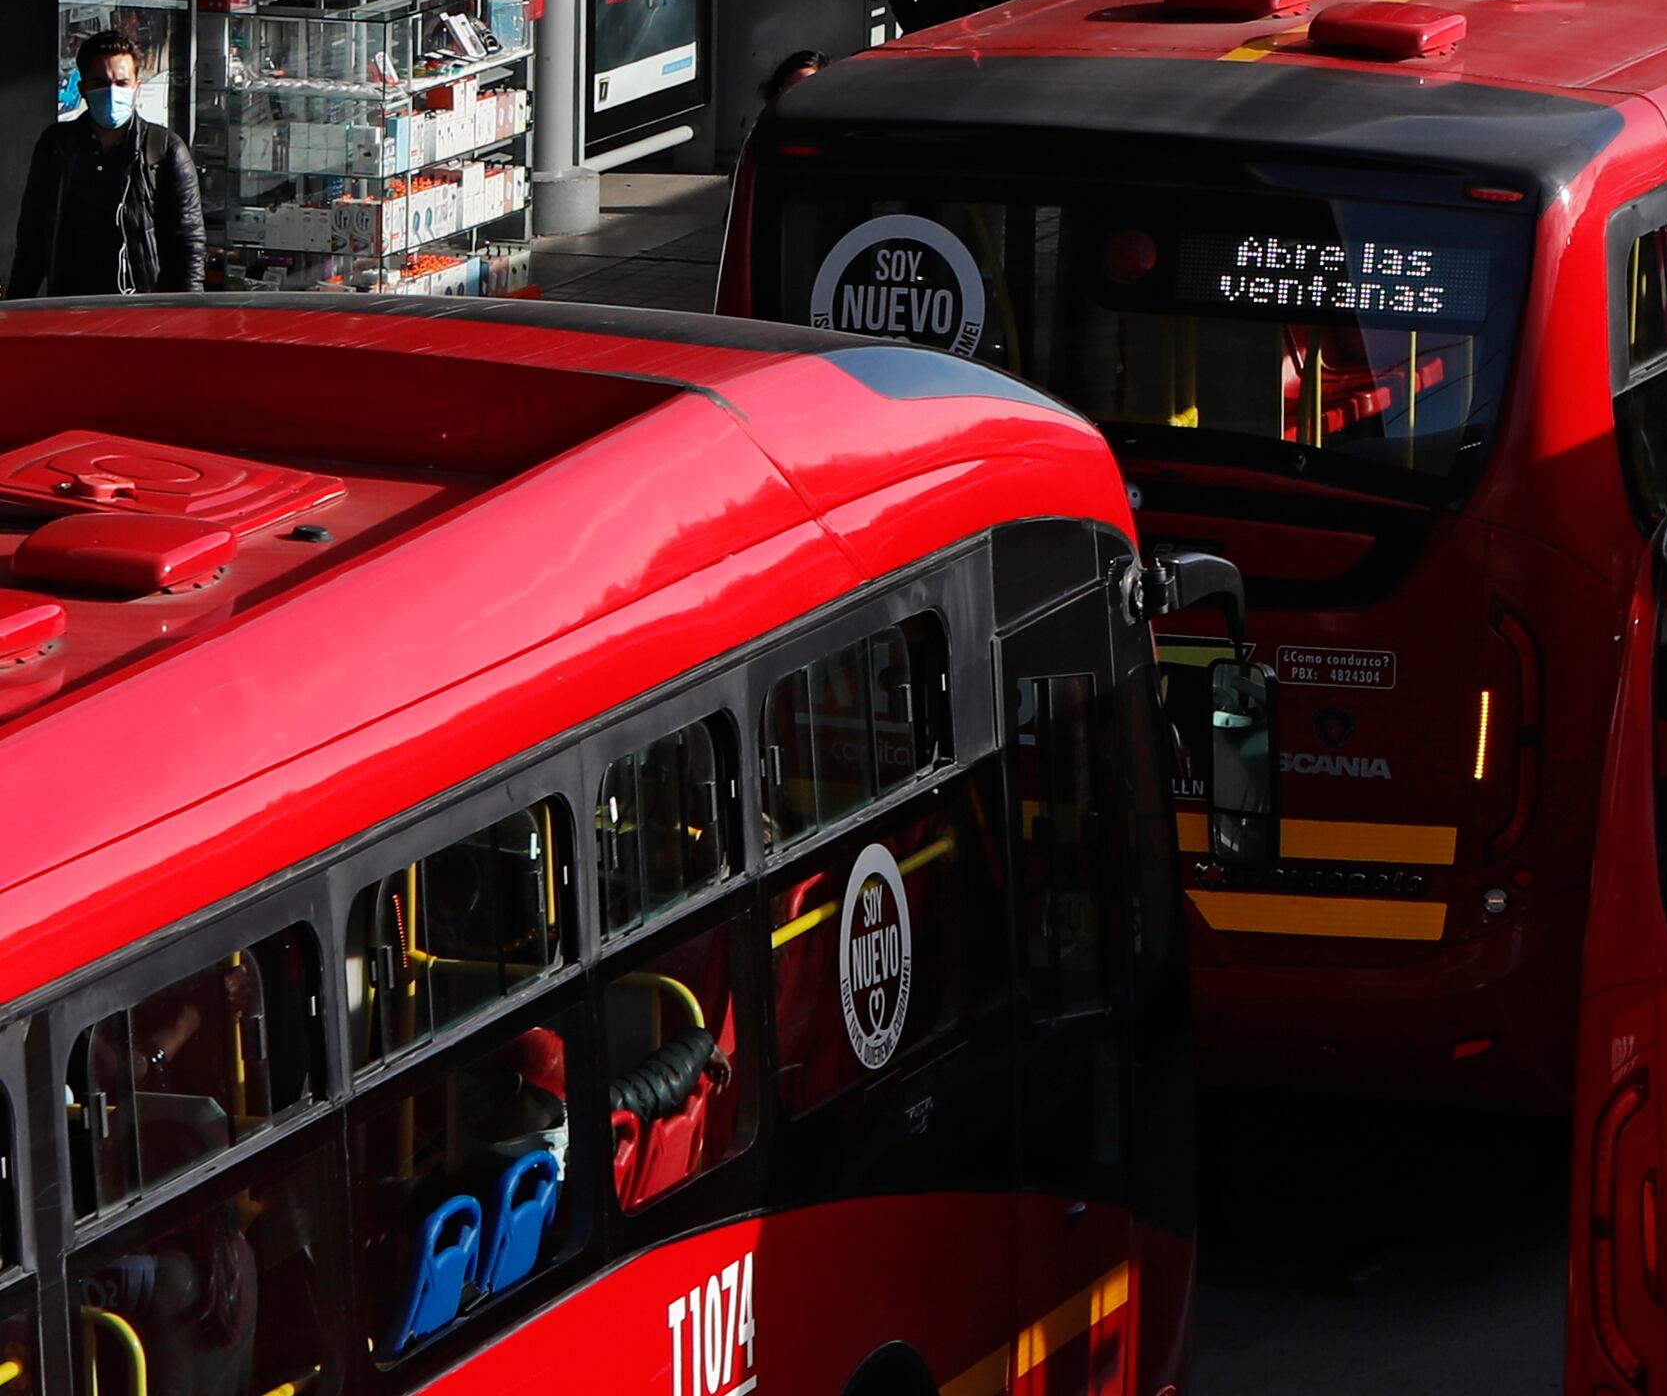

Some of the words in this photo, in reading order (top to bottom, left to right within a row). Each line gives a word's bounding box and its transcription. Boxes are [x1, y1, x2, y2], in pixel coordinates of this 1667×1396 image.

[875, 249, 923, 282] SOY
[1236, 236, 1345, 271] Abre
[1362, 242, 1433, 277] las
[841, 284, 954, 334] NUEVO
[1220, 275, 1444, 313] ventanas
[1329, 669, 1380, 684] 4824304
[1279, 751, 1391, 780] SCANIA
[863, 884, 883, 928] SOY
[852, 923, 900, 992] NUEVO
[668, 1251, 755, 1396] T1074
